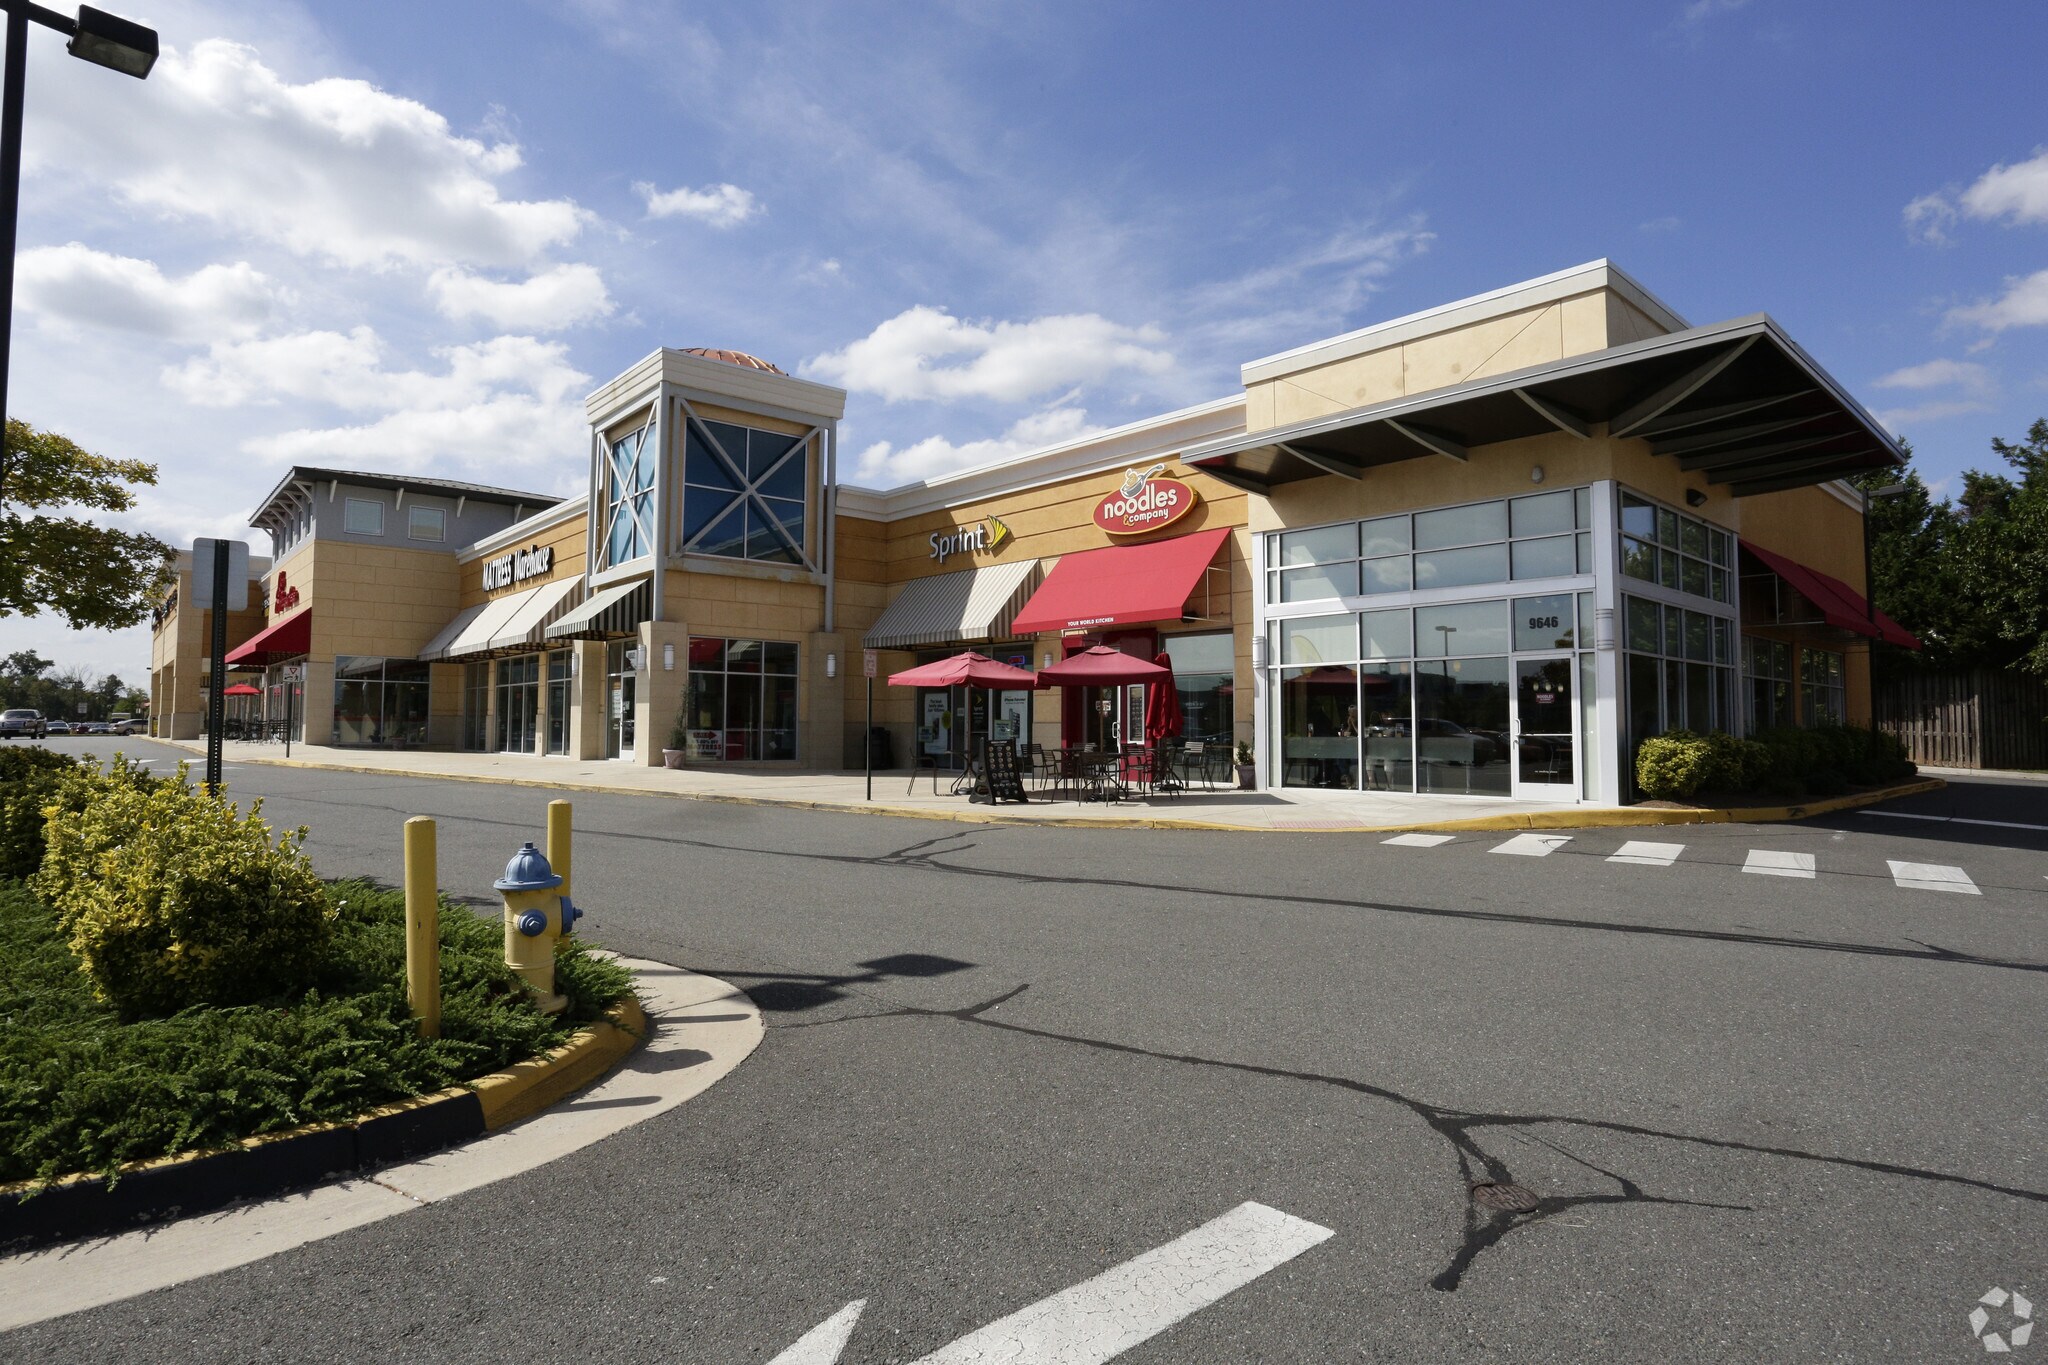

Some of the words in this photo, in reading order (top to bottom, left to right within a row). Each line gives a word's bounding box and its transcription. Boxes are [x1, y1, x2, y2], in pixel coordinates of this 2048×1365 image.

[1104, 483, 1178, 519] noodles
[929, 524, 984, 564] Sprint
[482, 554, 513, 592] MATTRESS
[513, 545, 552, 582] Warehouse
[1529, 616, 1559, 630] 9646
